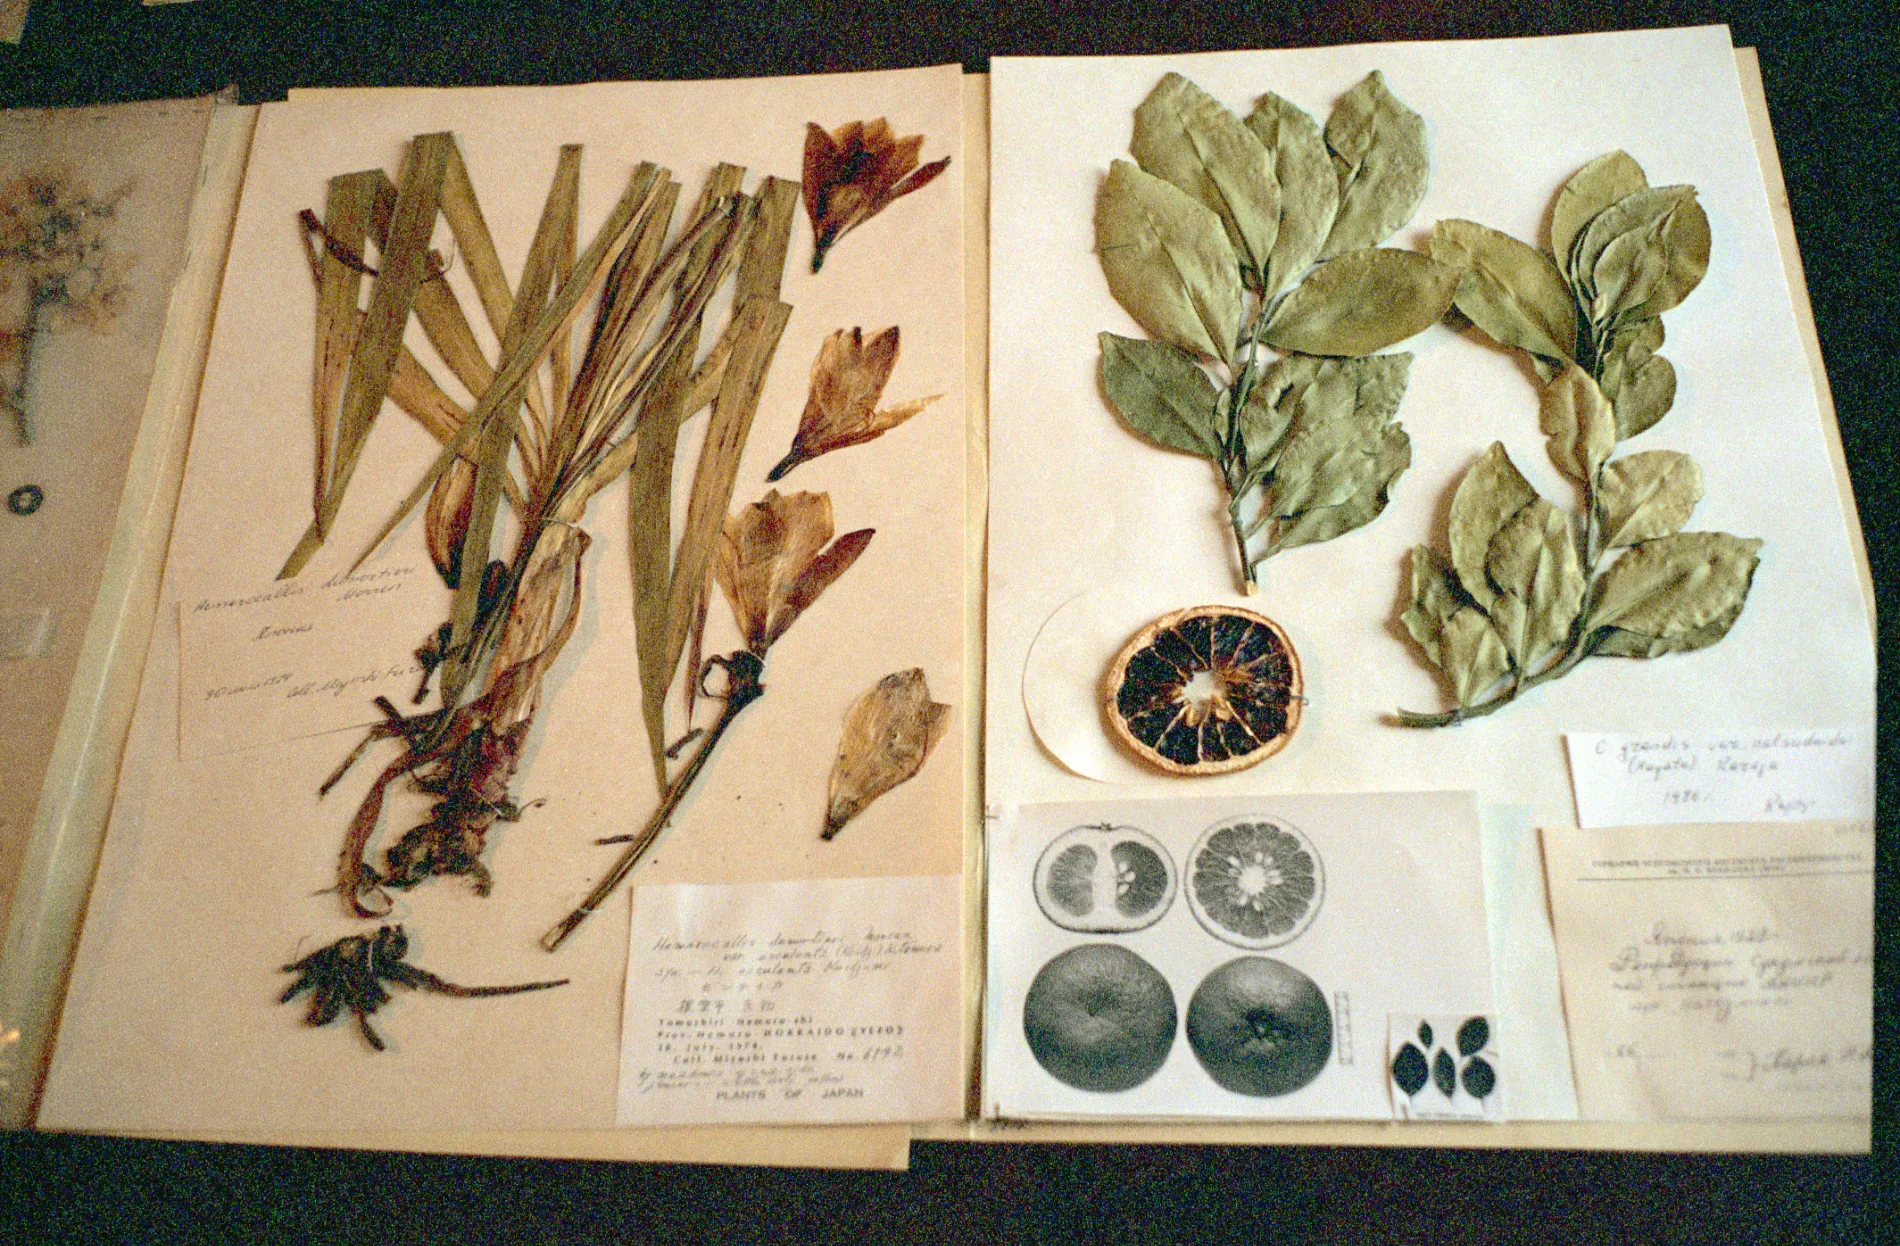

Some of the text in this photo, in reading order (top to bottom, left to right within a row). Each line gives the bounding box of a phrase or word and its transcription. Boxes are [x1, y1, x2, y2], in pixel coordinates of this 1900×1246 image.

[763, 1026, 845, 1037] HOKKAIDO
[716, 1088, 865, 1100] PLANTS OF JAPAN
